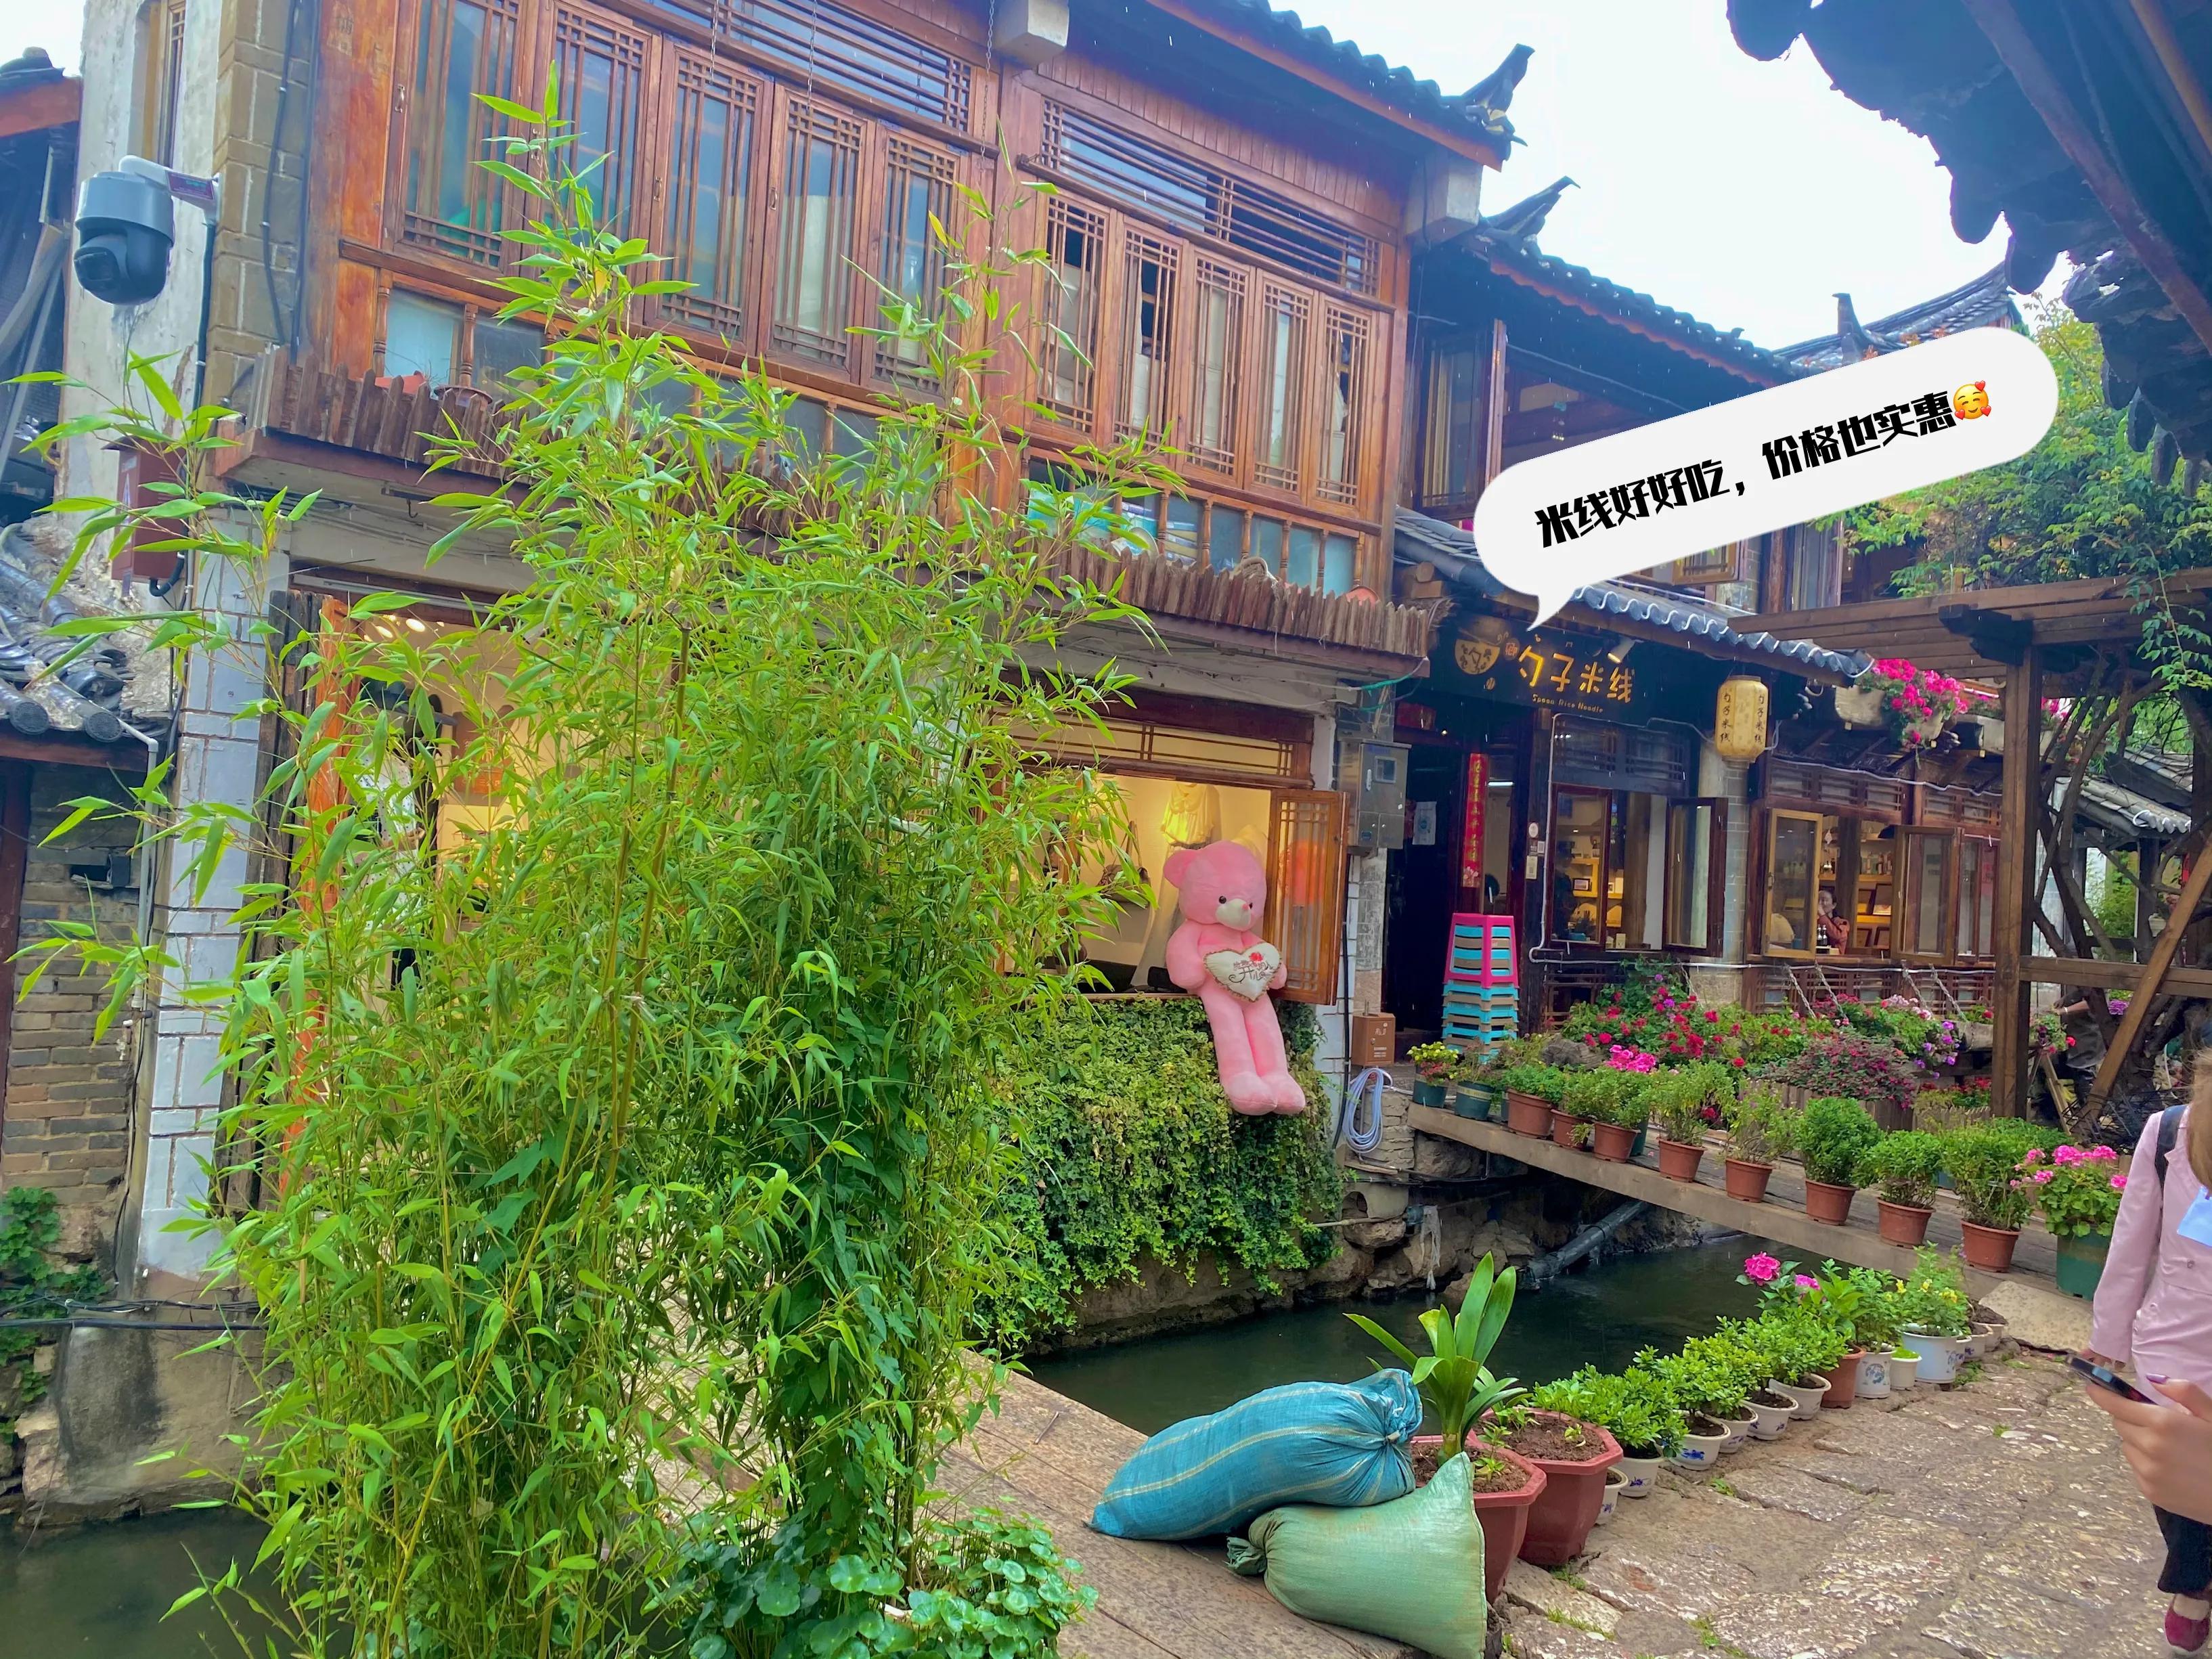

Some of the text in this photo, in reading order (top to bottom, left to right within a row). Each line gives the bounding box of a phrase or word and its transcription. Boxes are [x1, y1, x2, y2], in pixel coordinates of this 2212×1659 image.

[1518, 645, 1636, 704] 勺子米线
[1532, 694, 1603, 713] Spoon Rice Noodle
[1720, 692, 1731, 743] 勺子米线
